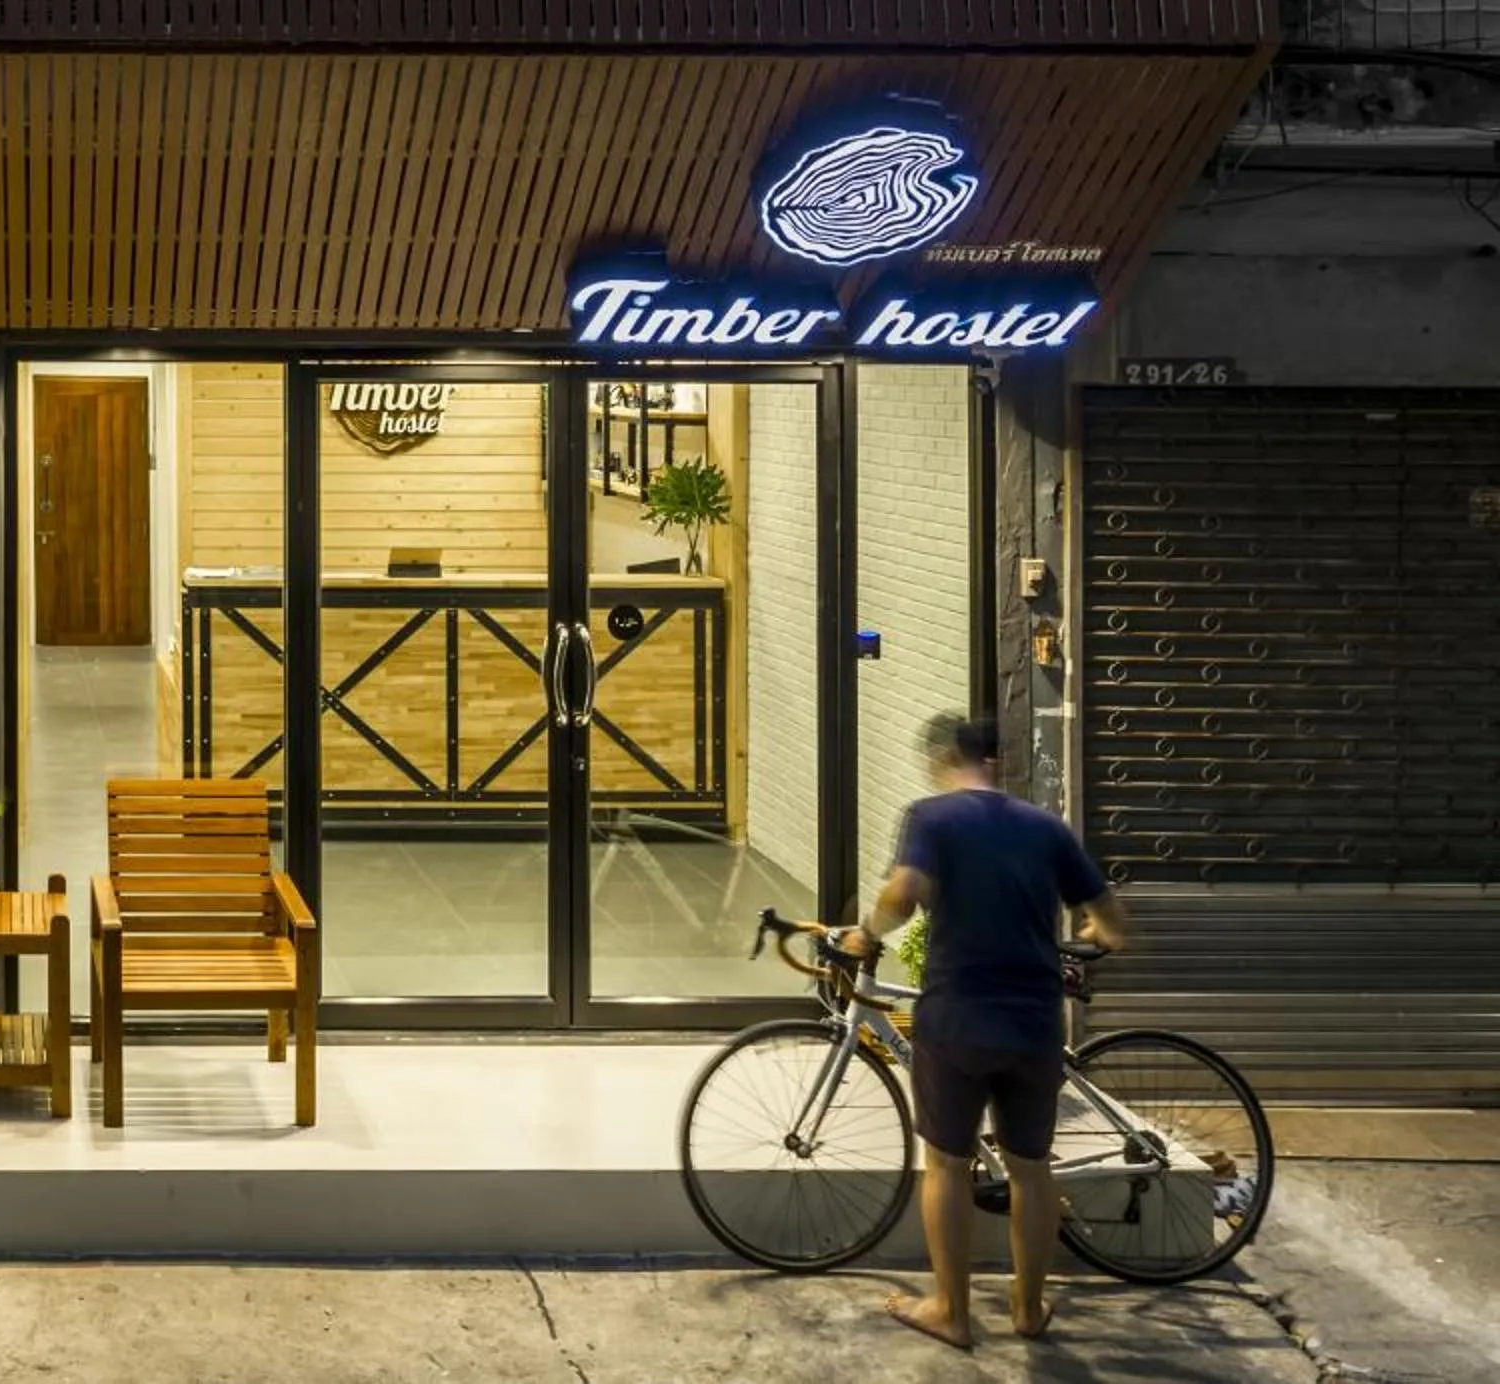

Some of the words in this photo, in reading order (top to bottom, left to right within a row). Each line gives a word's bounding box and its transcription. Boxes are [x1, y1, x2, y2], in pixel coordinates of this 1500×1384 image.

[571, 279, 841, 344] Timber
[855, 299, 1097, 347] hostel
[1125, 362, 1228, 385] 291/26
[378, 411, 445, 434] hostel
